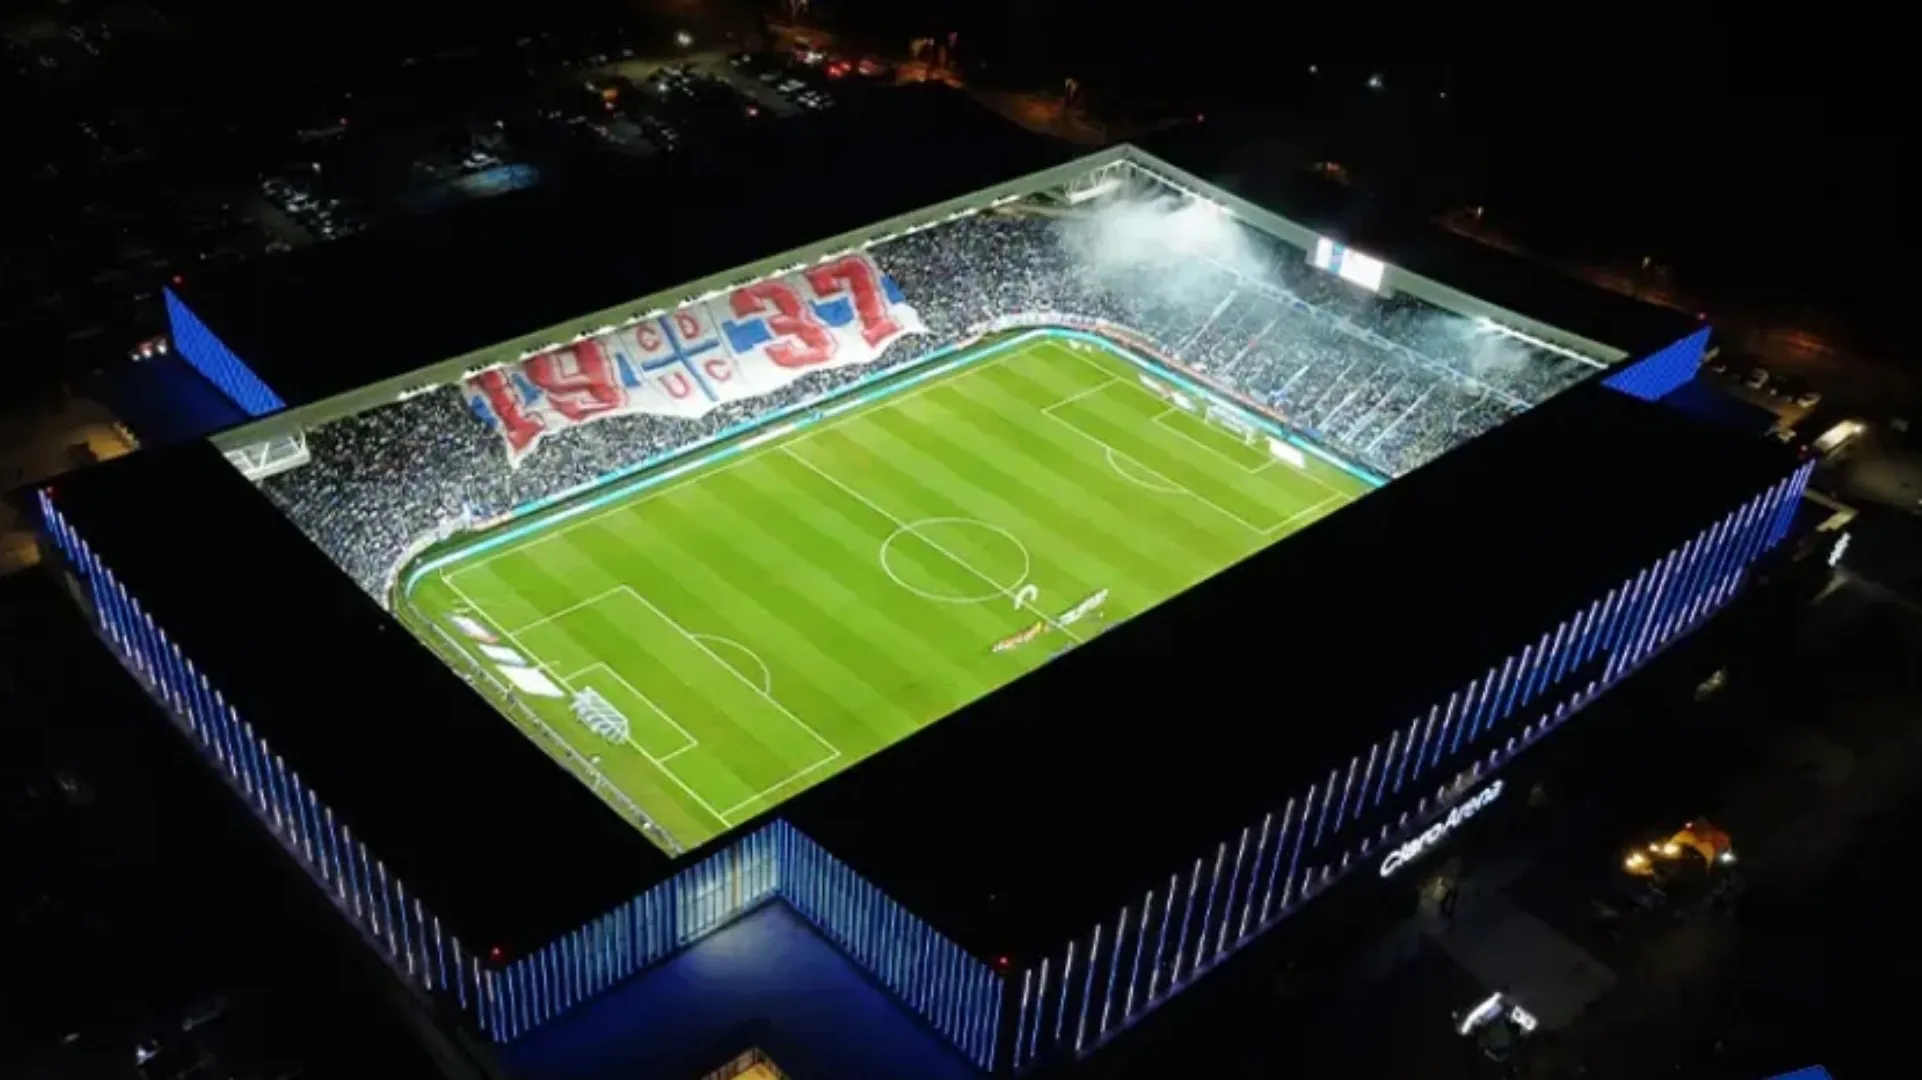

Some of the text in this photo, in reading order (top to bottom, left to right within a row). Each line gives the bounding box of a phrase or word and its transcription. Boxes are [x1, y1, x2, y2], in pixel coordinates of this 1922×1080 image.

[471, 255, 903, 453] 19 37
[1443, 780, 1503, 832] Arena
